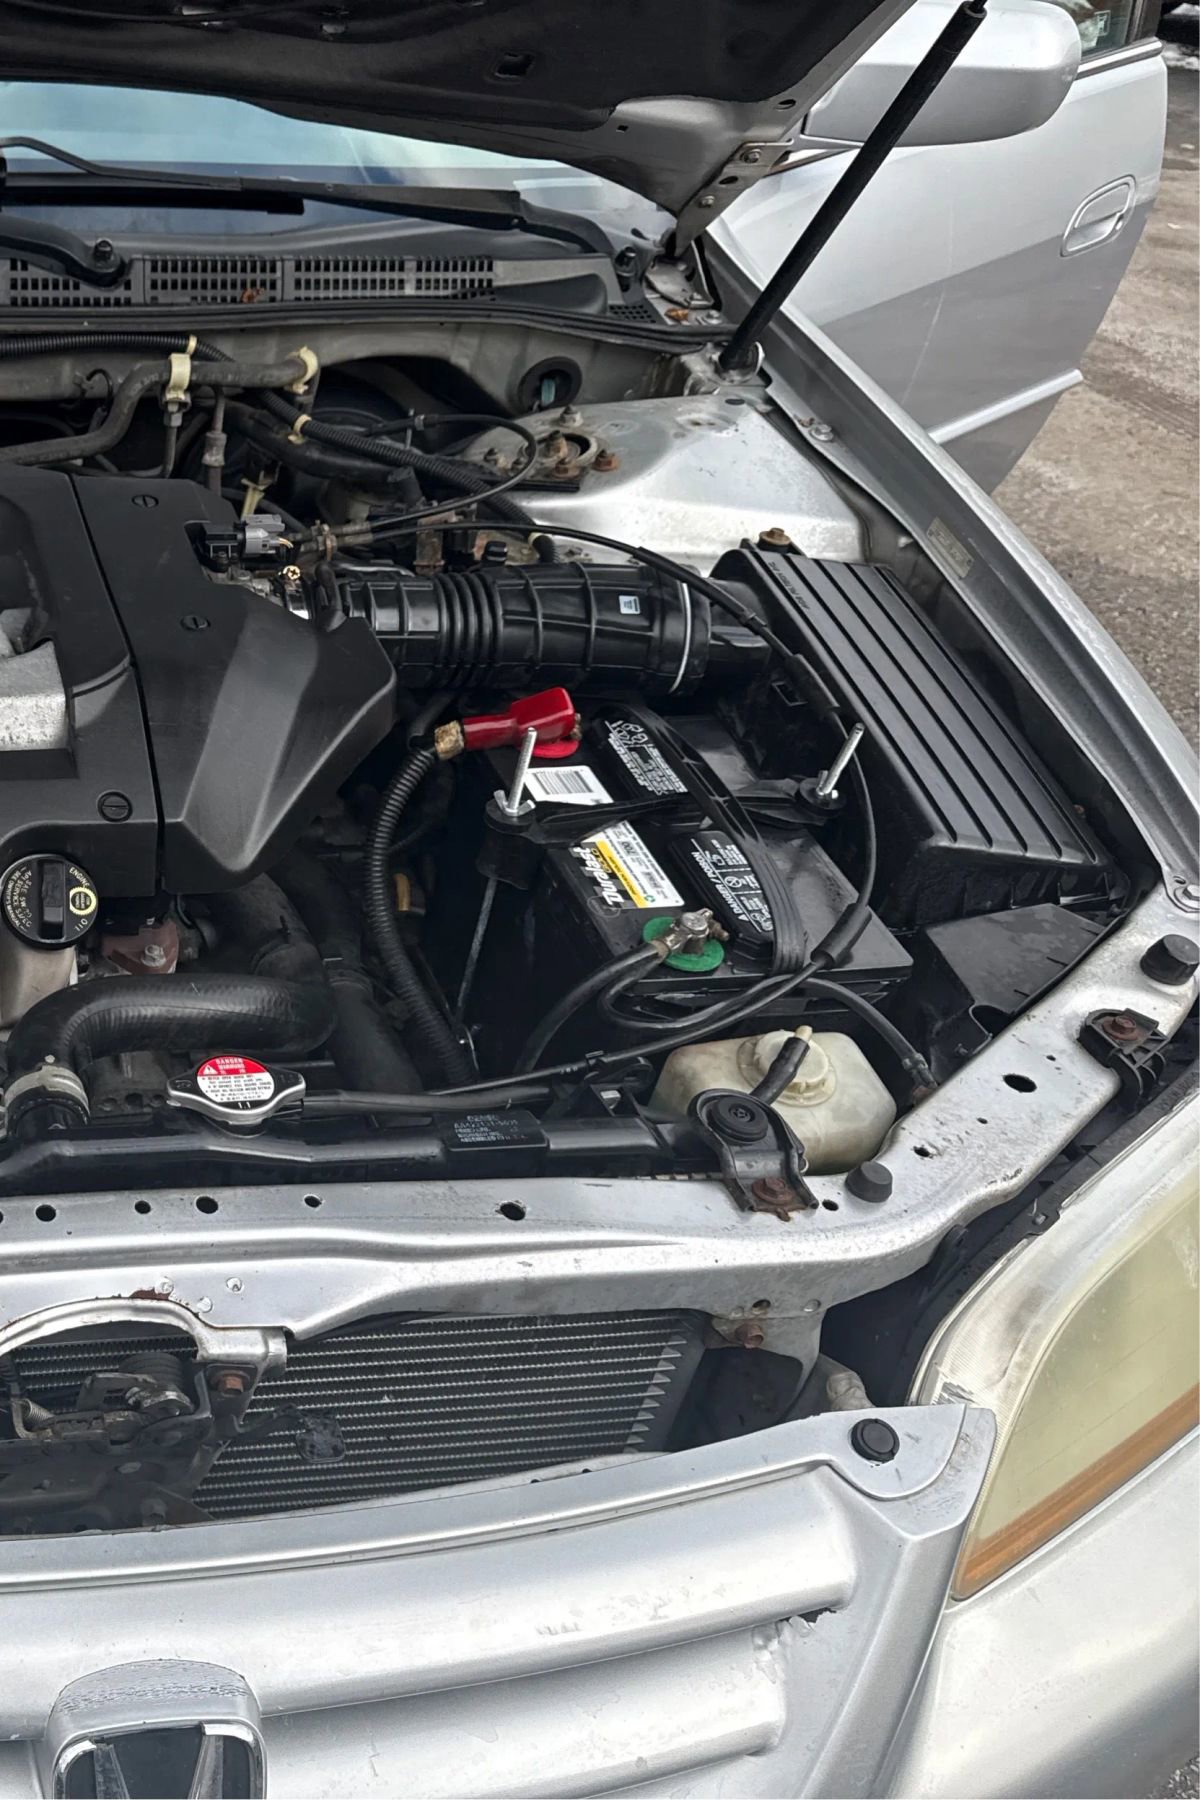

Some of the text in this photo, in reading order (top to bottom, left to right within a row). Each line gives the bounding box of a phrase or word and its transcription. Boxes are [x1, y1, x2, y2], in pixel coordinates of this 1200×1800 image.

[590, 847, 612, 874] GOLD
[691, 851, 713, 879] POISON
[69, 866, 90, 889] ENGINE
[574, 846, 625, 905] Duralast
[715, 884, 740, 915] DANGER
[74, 918, 88, 932] OIL
